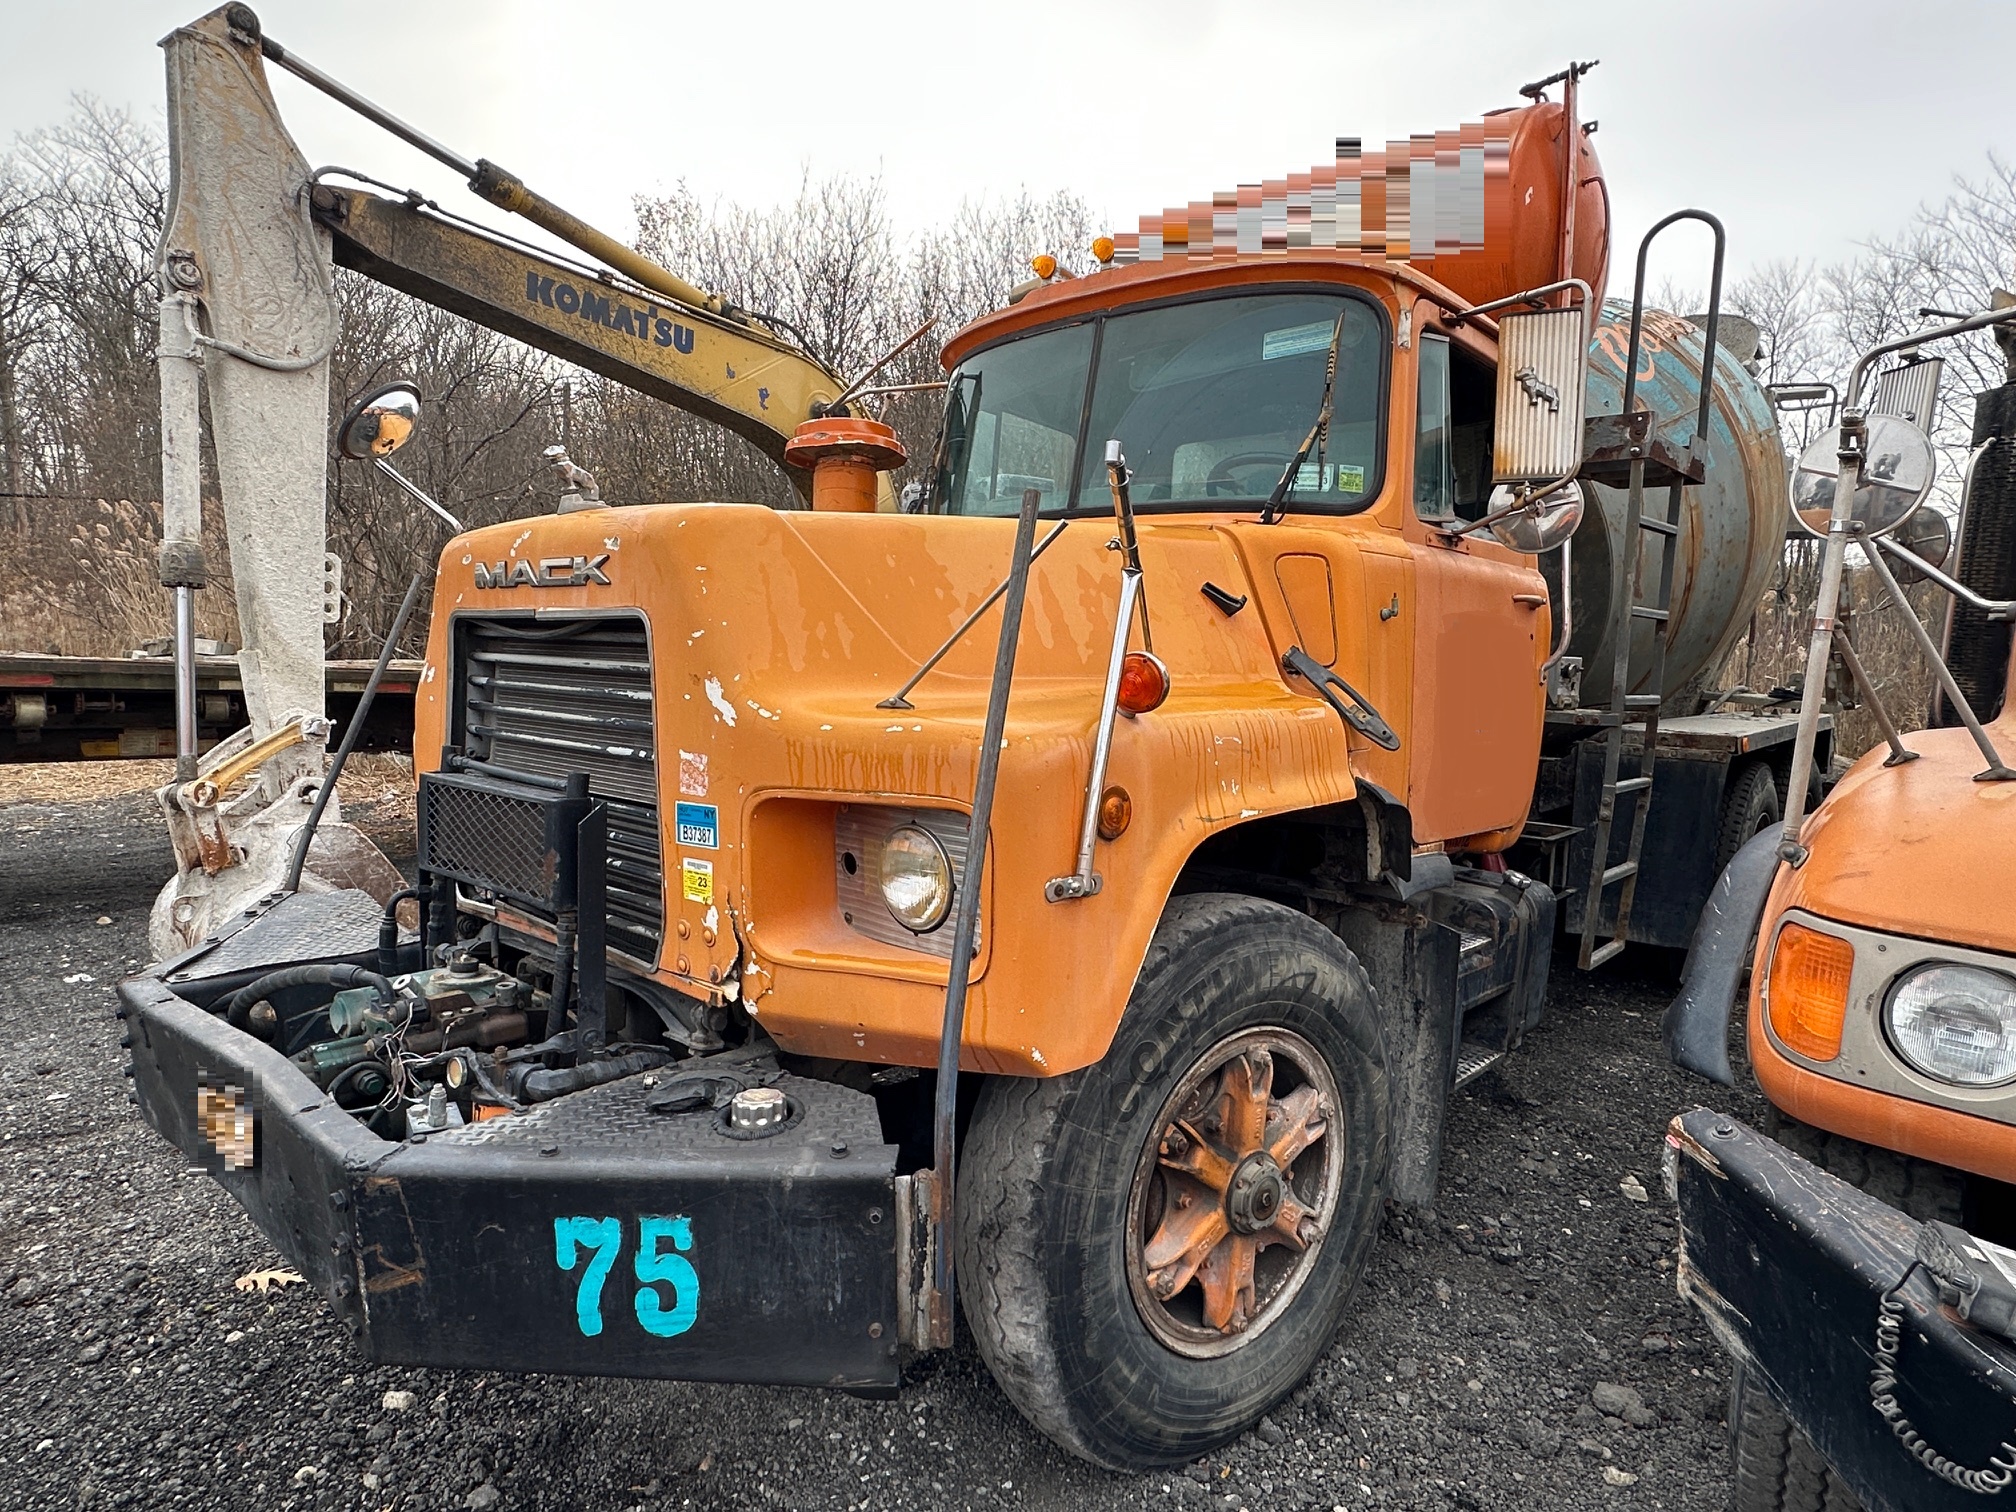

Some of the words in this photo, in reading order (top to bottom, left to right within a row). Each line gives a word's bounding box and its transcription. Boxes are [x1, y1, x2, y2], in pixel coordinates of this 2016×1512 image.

[526, 271, 694, 355] KOMATSU
[474, 554, 611, 589] MACK
[704, 809, 716, 820] NY
[683, 825, 711, 843] B37387
[697, 876, 708, 888] 23
[554, 1215, 700, 1337] 75
